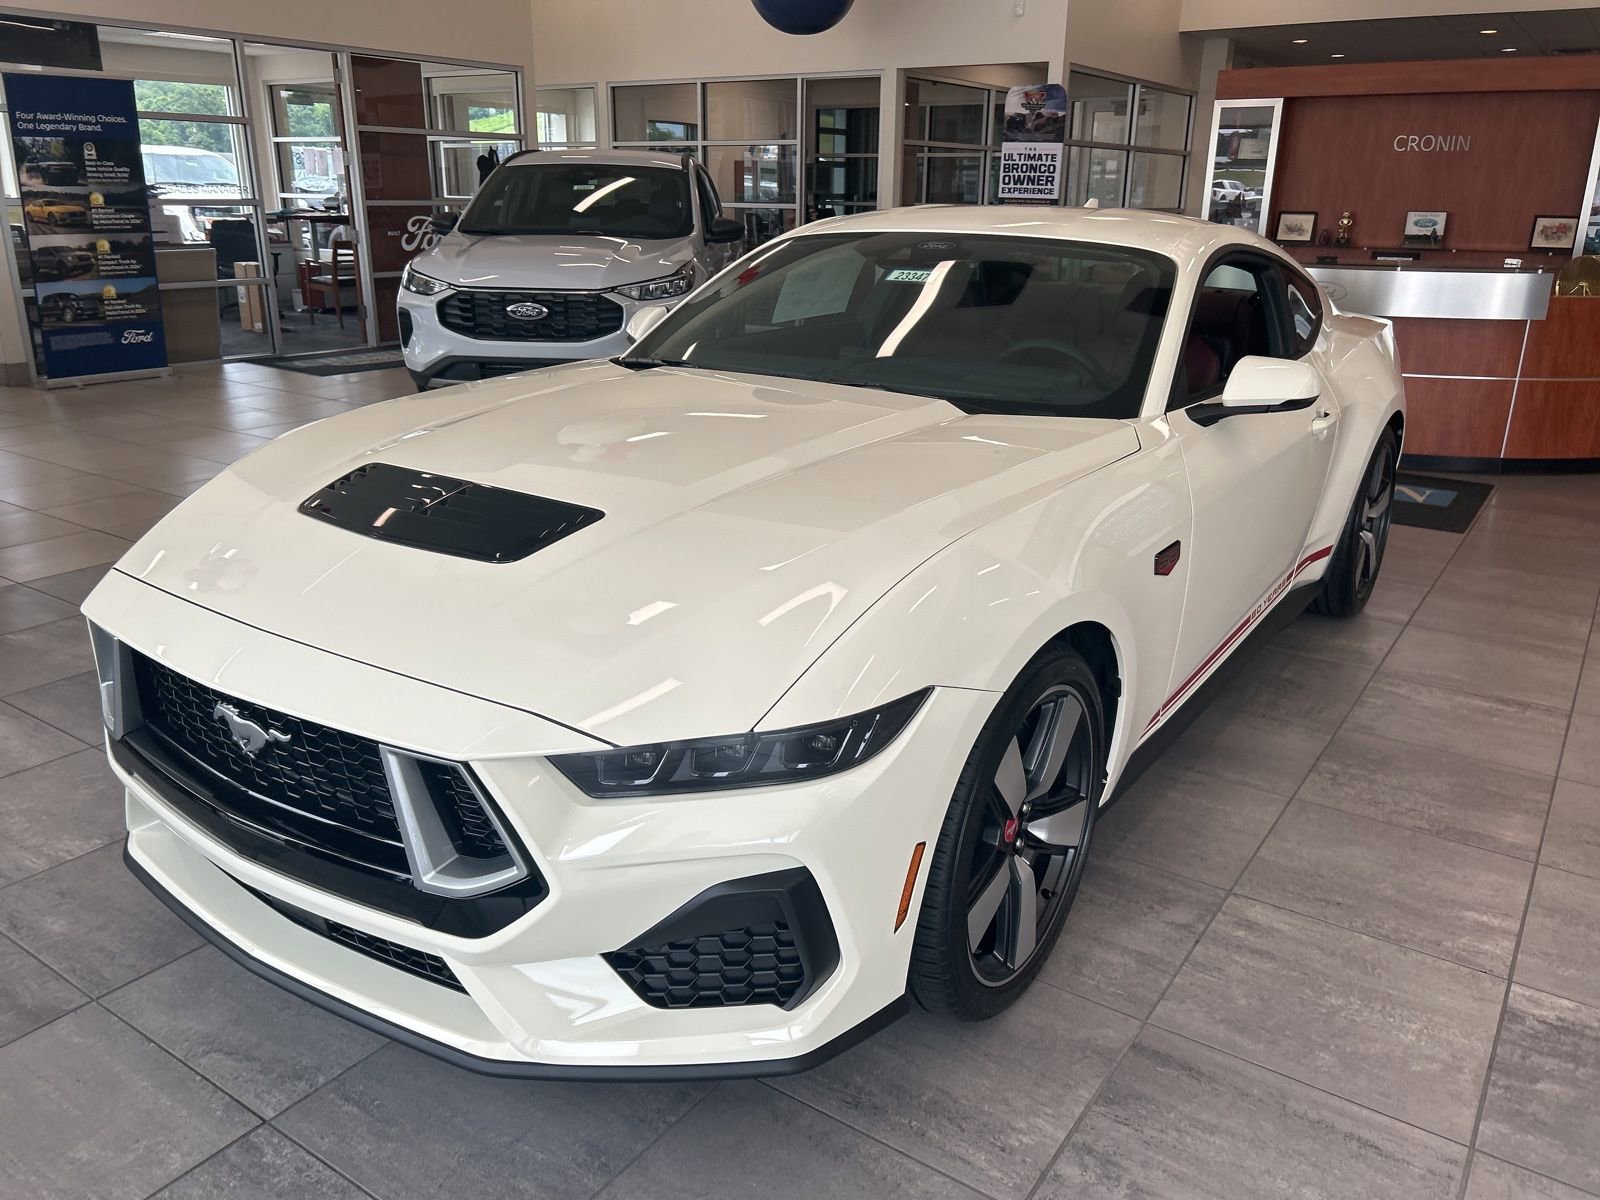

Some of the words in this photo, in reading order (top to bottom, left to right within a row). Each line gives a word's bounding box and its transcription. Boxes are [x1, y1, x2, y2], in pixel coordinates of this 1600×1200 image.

[15, 111, 34, 120] Four
[36, 112, 96, 124] Award-Winning
[97, 114, 128, 123] Choices.
[17, 121, 35, 129] One
[36, 122, 76, 132] Legendary
[78, 123, 103, 132] Brand.
[1393, 134, 1471, 152] CRONIN
[1003, 153, 1057, 162] ULTIMATE
[1002, 163, 1057, 174] BRONCO
[1002, 175, 1055, 186] OWNER
[167, 186, 200, 194] SALES
[202, 185, 250, 194] MANAGER
[1001, 187, 1055, 195] EXPERIENCE
[894, 271, 931, 281] 23347
[514, 305, 540, 316] Ford
[121, 329, 153, 344] Ford
[1263, 578, 1287, 607] YEARS
